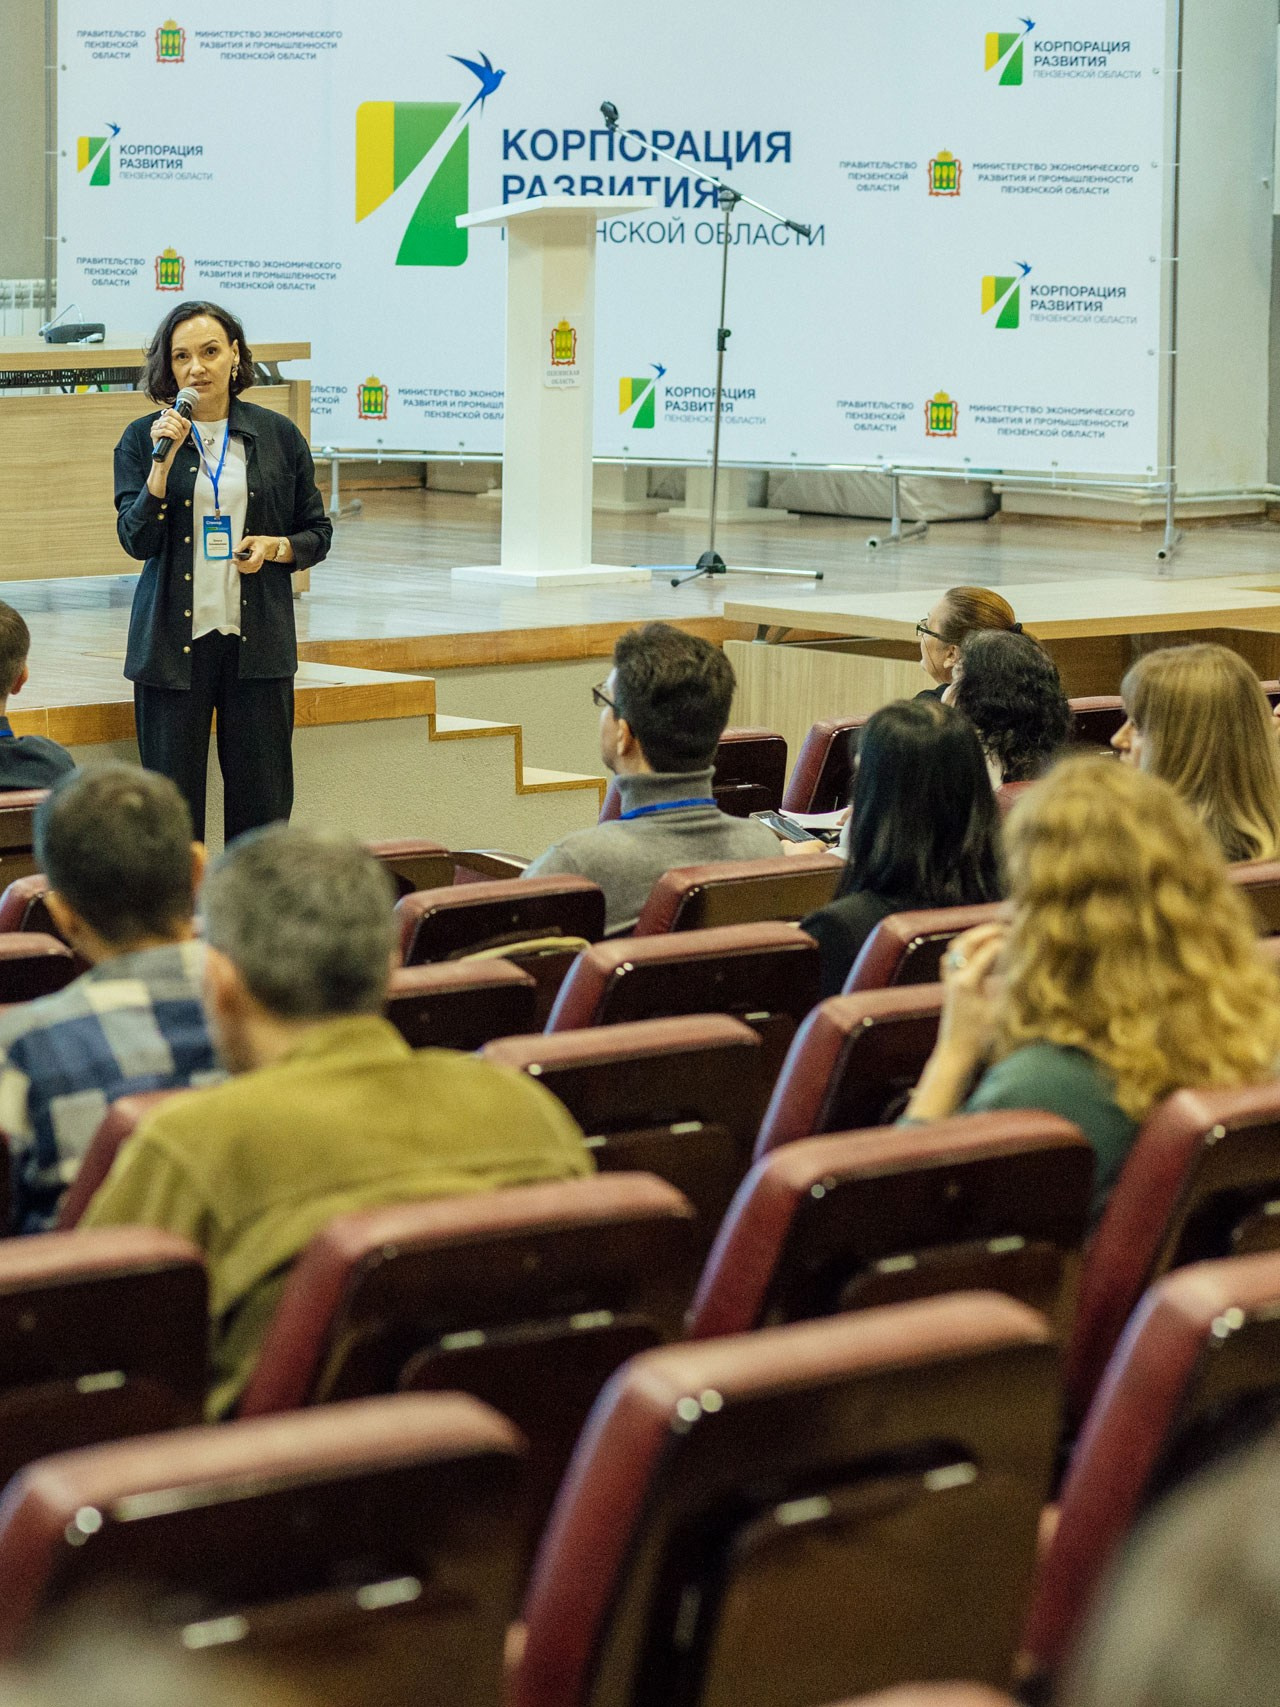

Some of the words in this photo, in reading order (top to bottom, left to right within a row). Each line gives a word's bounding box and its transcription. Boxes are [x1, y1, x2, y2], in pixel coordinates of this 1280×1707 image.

[77, 30, 146, 38] ПРАВИТЕЛЬСТВО
[263, 31, 342, 39] ЭКОНОМИЧЕСКОГО
[85, 40, 138, 48] ПЕНЗЕНСКОЙ
[1034, 41, 1130, 54] КОРПОРАЦИЯ
[220, 52, 275, 60] ПЕНЗЕНСКОЙ
[1034, 56, 1107, 66] РАЗВИТИЯ
[1034, 68, 1096, 78] ПЕНЗЕНСКОЙ
[1098, 70, 1141, 79] ОБЛАСТИ
[120, 145, 203, 157] КОРПОРАЦИЯ
[502, 129, 791, 170] КОРПОРАЦИЯ
[120, 159, 183, 169] РАЗВИТИЯ
[840, 161, 917, 169] ПРАВИТЕЛЬСТВО
[973, 162, 1047, 171] МИНИСТЕРСТВО
[1049, 164, 1139, 172] ЭКОНОМИЧЕСКОГО
[120, 171, 173, 180] ПЕНЗЕНСКОЙ
[175, 172, 213, 180] ОБЛАСТИ
[848, 172, 908, 180] ПЕНЗЕНСКОЙ
[978, 174, 1027, 182] РАЗВИТИЯ
[1038, 175, 1133, 183] ПРОМЫШЛЕННОСТИ
[857, 184, 899, 192] ОБЛАСТИ
[1001, 184, 1063, 194] ПЕНЗЕНСКОЙ
[1066, 186, 1109, 194] ОБЛАСТИ
[77, 257, 145, 266] ПРАВИТЕЛЬСТВО
[194, 260, 260, 268] МИНИСТЕРСТВО
[262, 261, 341, 270] ЭКОНОМИЧЕСКОГО
[84, 267, 137, 276] ПЕНЗЕНСКОЙ
[200, 271, 242, 279] РАЗВИТИЯ
[252, 272, 336, 280] ПРОМЫШЛЕННОСТИ
[220, 280, 274, 289] ПЕНЗЕНСКОЙ
[276, 282, 316, 290] ОБЛАСТИ
[1030, 285, 1126, 299] КОРПОРАЦИЯ
[1030, 300, 1103, 312] РАЗВИТИЯ
[1030, 312, 1092, 323] ПЕНЗЕНСКОЙ
[1094, 314, 1137, 324] ОБЛАСТИ
[398, 388, 466, 397] МИНИСТЕРСТВО
[311, 395, 339, 404] НСКОЙ
[404, 399, 448, 407] РАЗВИТИЯ
[458, 400, 504, 408] ПРОМЫШЛ
[837, 401, 913, 409] ПРАВИТЕЛЬСТВО
[310, 407, 332, 415] АСТИ
[424, 410, 480, 419] ПЕНЗЕНСКОЙ
[970, 404, 1043, 414] МИНИСТЕРСТВО
[1046, 406, 1134, 417] ЭКОНОМИЧЕСКОГО
[664, 413, 723, 423] ПЕНЗЕНСКО
[725, 415, 766, 425] ОБЛАСТИ
[845, 411, 905, 420] ПЕНЗЕНСКОЙ
[975, 416, 1023, 425] РАЗВИТИЯ
[1025, 417, 1032, 425] И
[1035, 417, 1128, 427] ПРОМЫШЛЕННОСТИ
[854, 423, 897, 431] ОБЛАСТИ
[998, 427, 1059, 437] ПЕНЗЕНСКОЙ
[1061, 429, 1105, 438] ОБЛАСТИ
